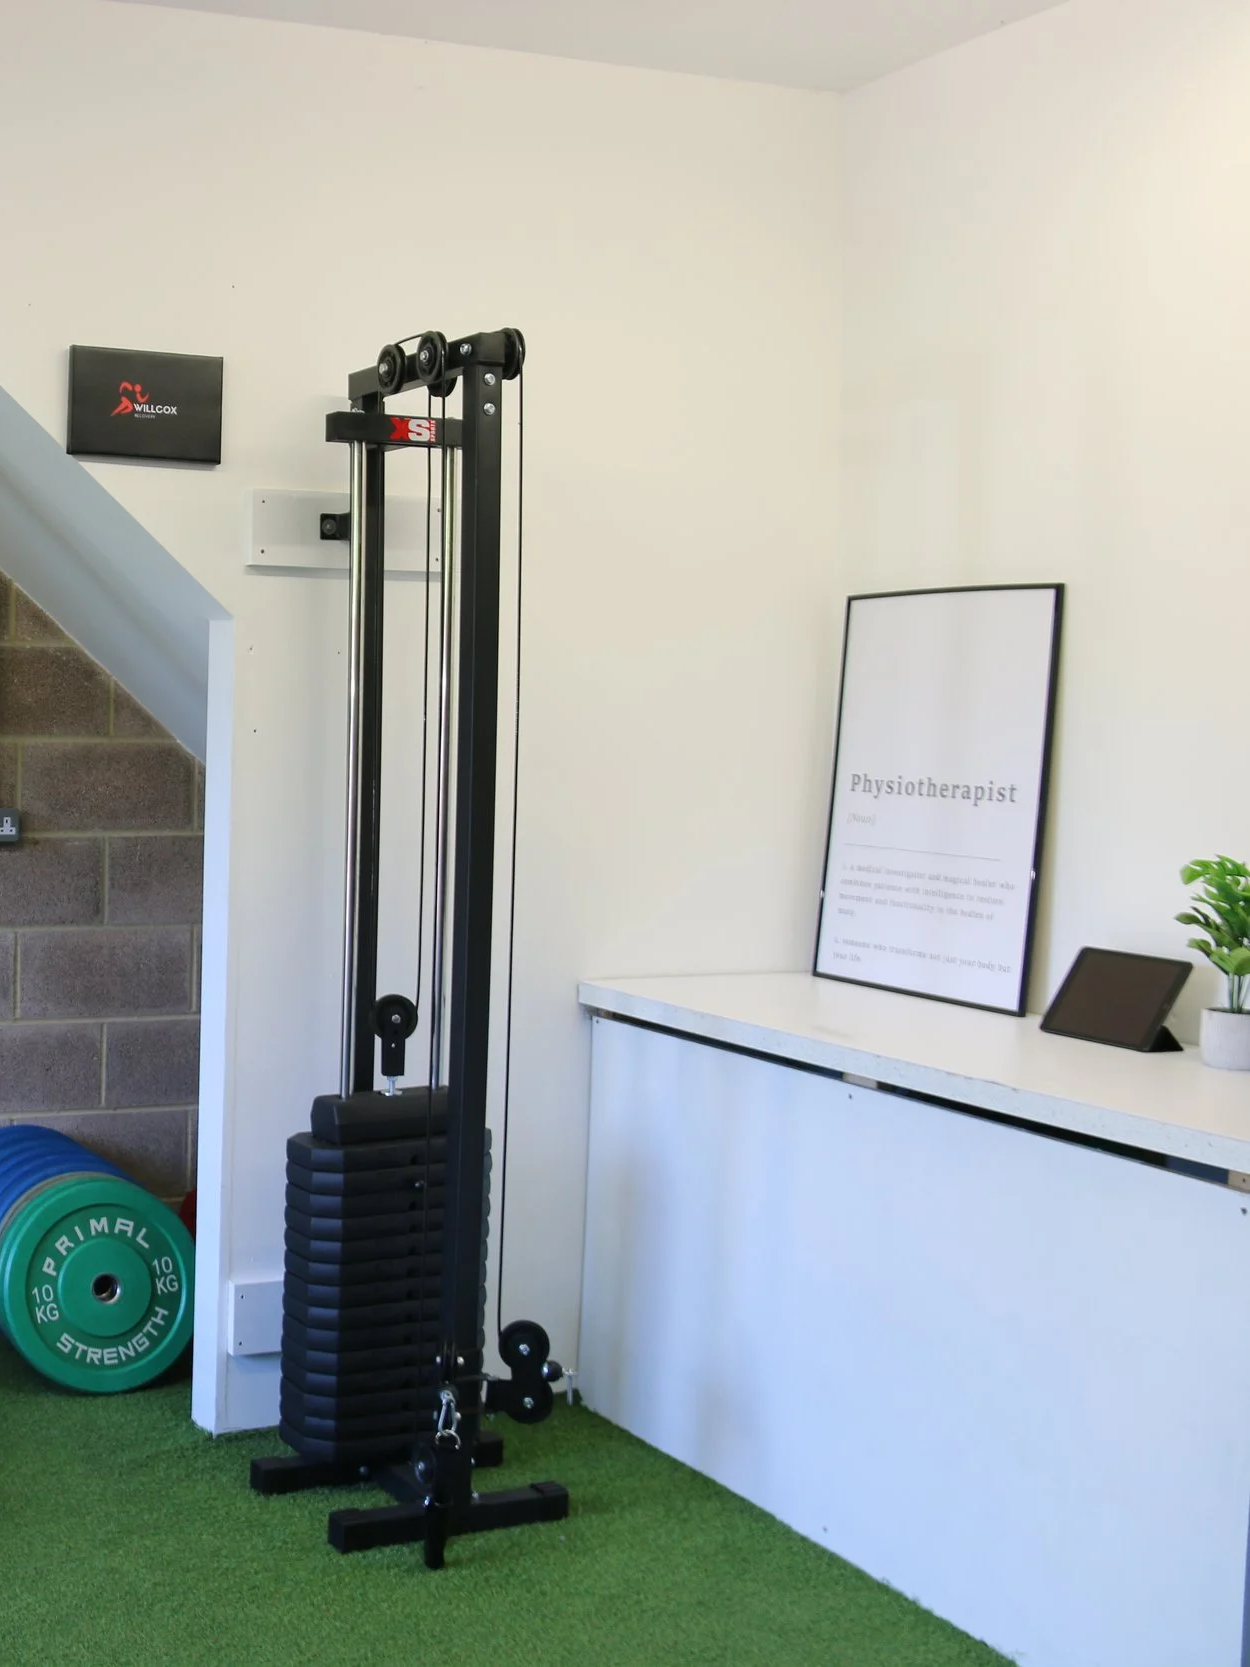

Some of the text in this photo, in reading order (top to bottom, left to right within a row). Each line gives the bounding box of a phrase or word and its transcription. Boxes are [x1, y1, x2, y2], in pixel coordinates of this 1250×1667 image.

[133, 403, 177, 415] WILLCOX
[390, 417, 430, 442] XS
[849, 773, 1018, 807] Physiotherapist
[42, 1216, 150, 1277] PRIMAL
[152, 1256, 173, 1275] 10
[31, 1284, 54, 1304] 10
[155, 1275, 179, 1296] KG
[35, 1303, 59, 1324] KG
[56, 1306, 169, 1365] STRENGTH
